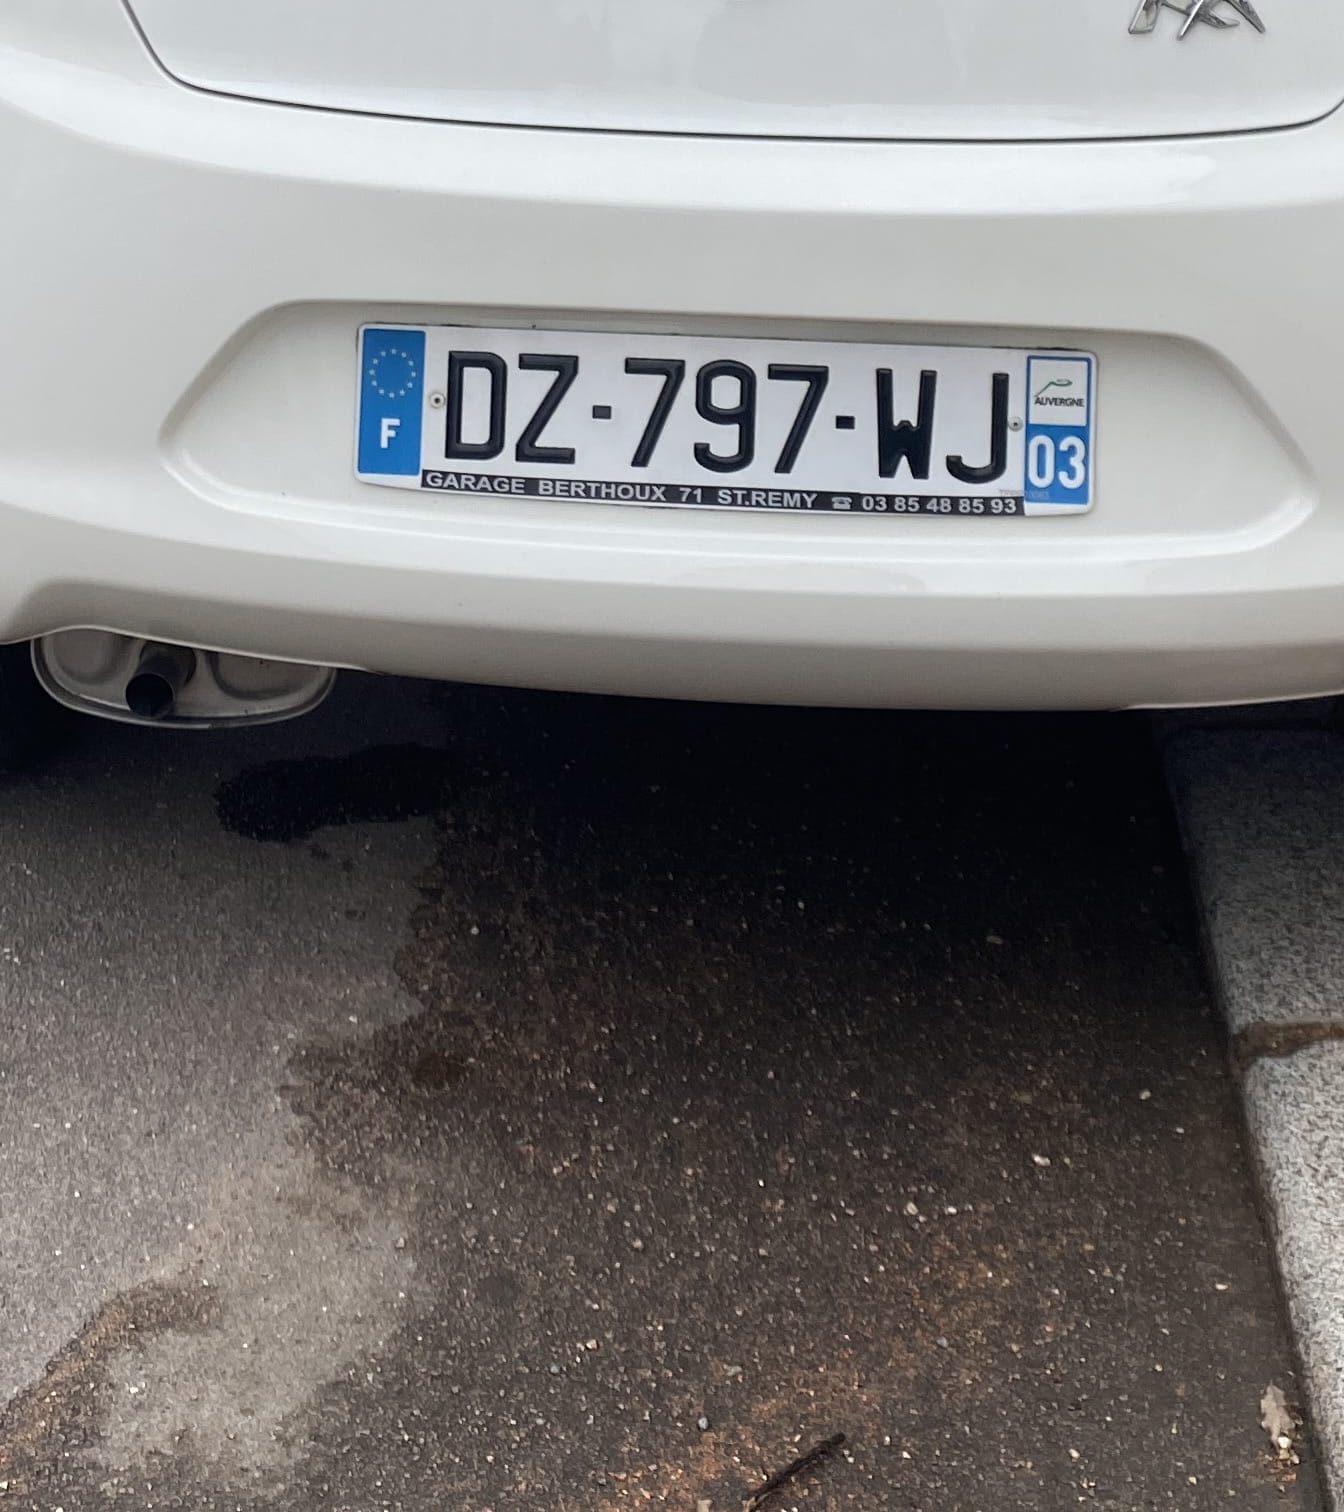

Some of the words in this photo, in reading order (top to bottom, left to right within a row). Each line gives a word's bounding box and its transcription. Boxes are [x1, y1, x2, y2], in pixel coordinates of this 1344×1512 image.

[444, 350, 1009, 484] DZ-797-WJ
[1034, 396, 1085, 407] AUVERGNE
[380, 418, 400, 448] F
[1028, 435, 1085, 489] 03
[426, 472, 525, 493] GARAGE
[538, 479, 666, 502] BERTHOUX
[679, 487, 702, 503] 71
[717, 490, 818, 509] ST.REMY
[861, 495, 888, 512] 03
[893, 496, 920, 513] 85
[926, 497, 953, 514] 48
[958, 498, 985, 514] 85
[990, 498, 1017, 514] 93
